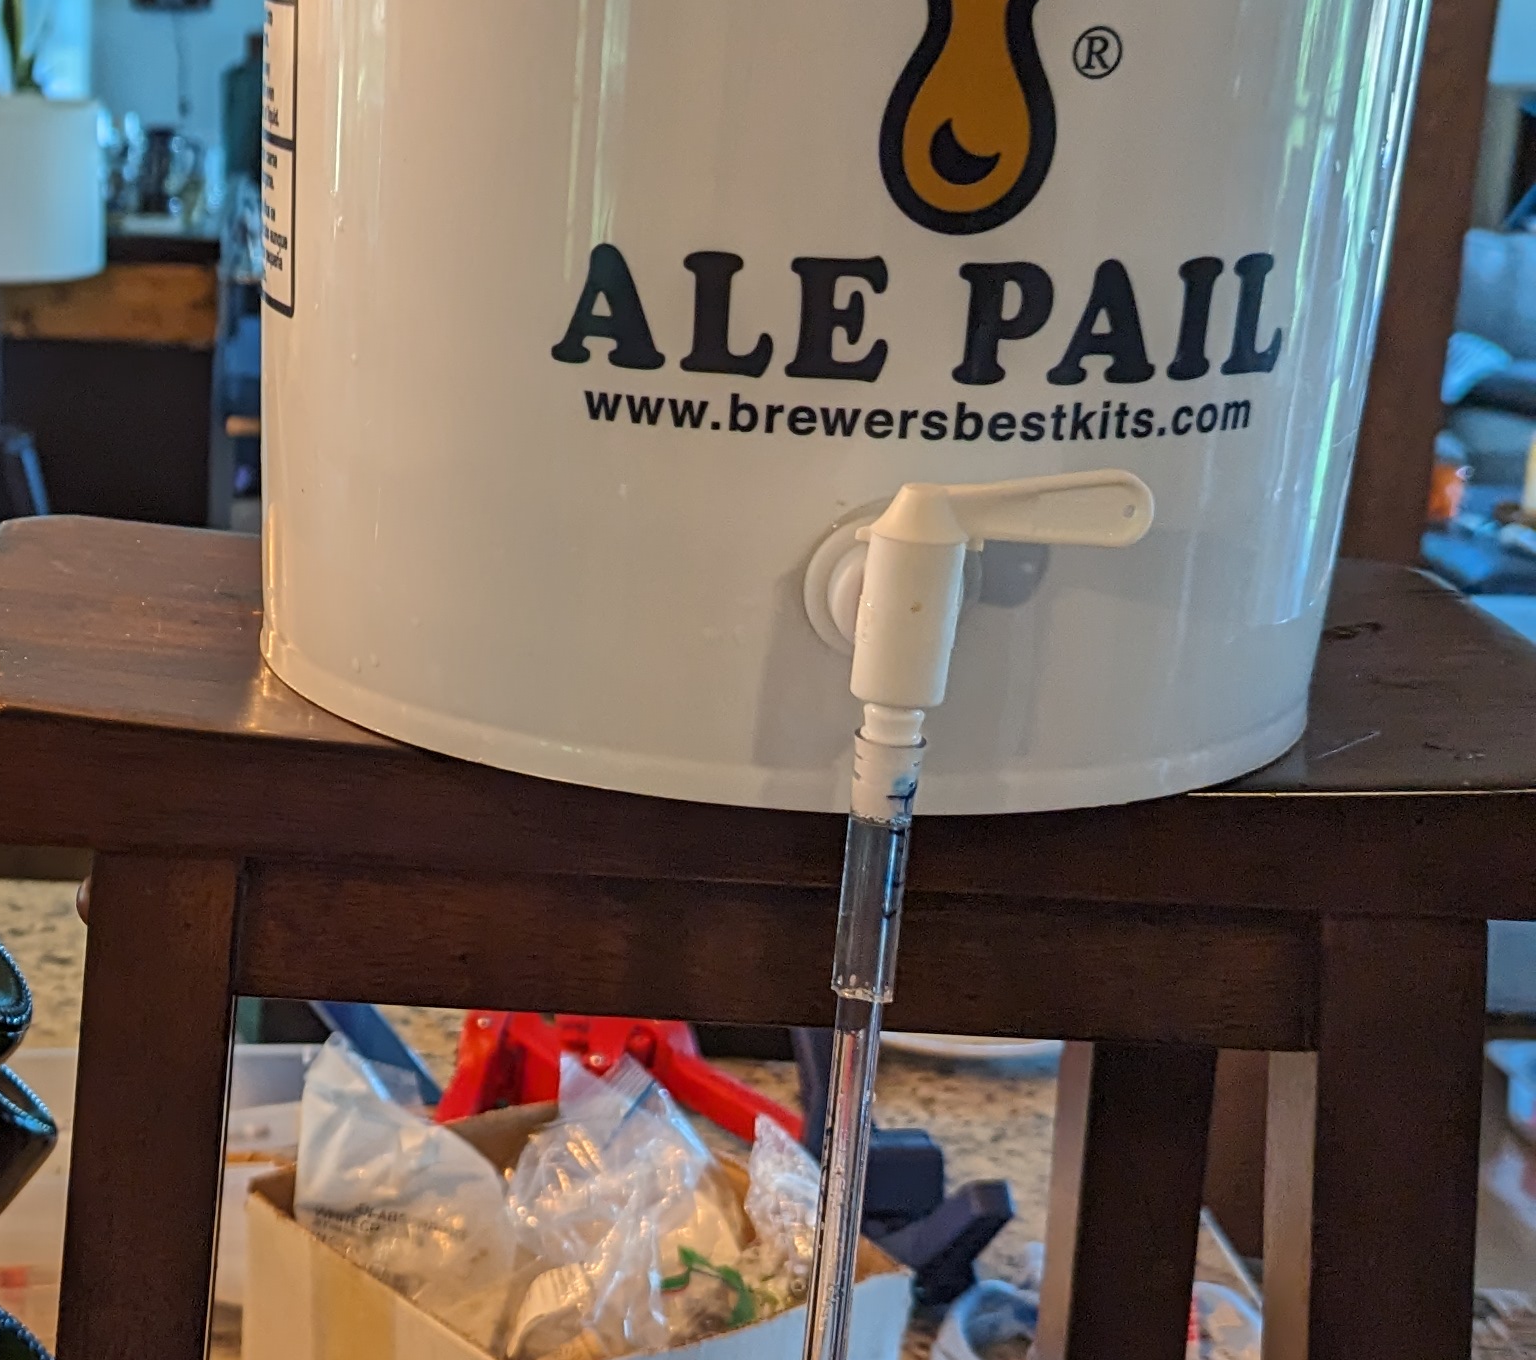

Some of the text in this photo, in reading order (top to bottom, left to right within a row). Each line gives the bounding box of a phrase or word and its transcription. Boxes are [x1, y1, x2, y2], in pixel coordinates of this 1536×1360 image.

[550, 242, 1283, 387] ALE PAIL
[583, 389, 1252, 443] www.brewersbestkits.com
